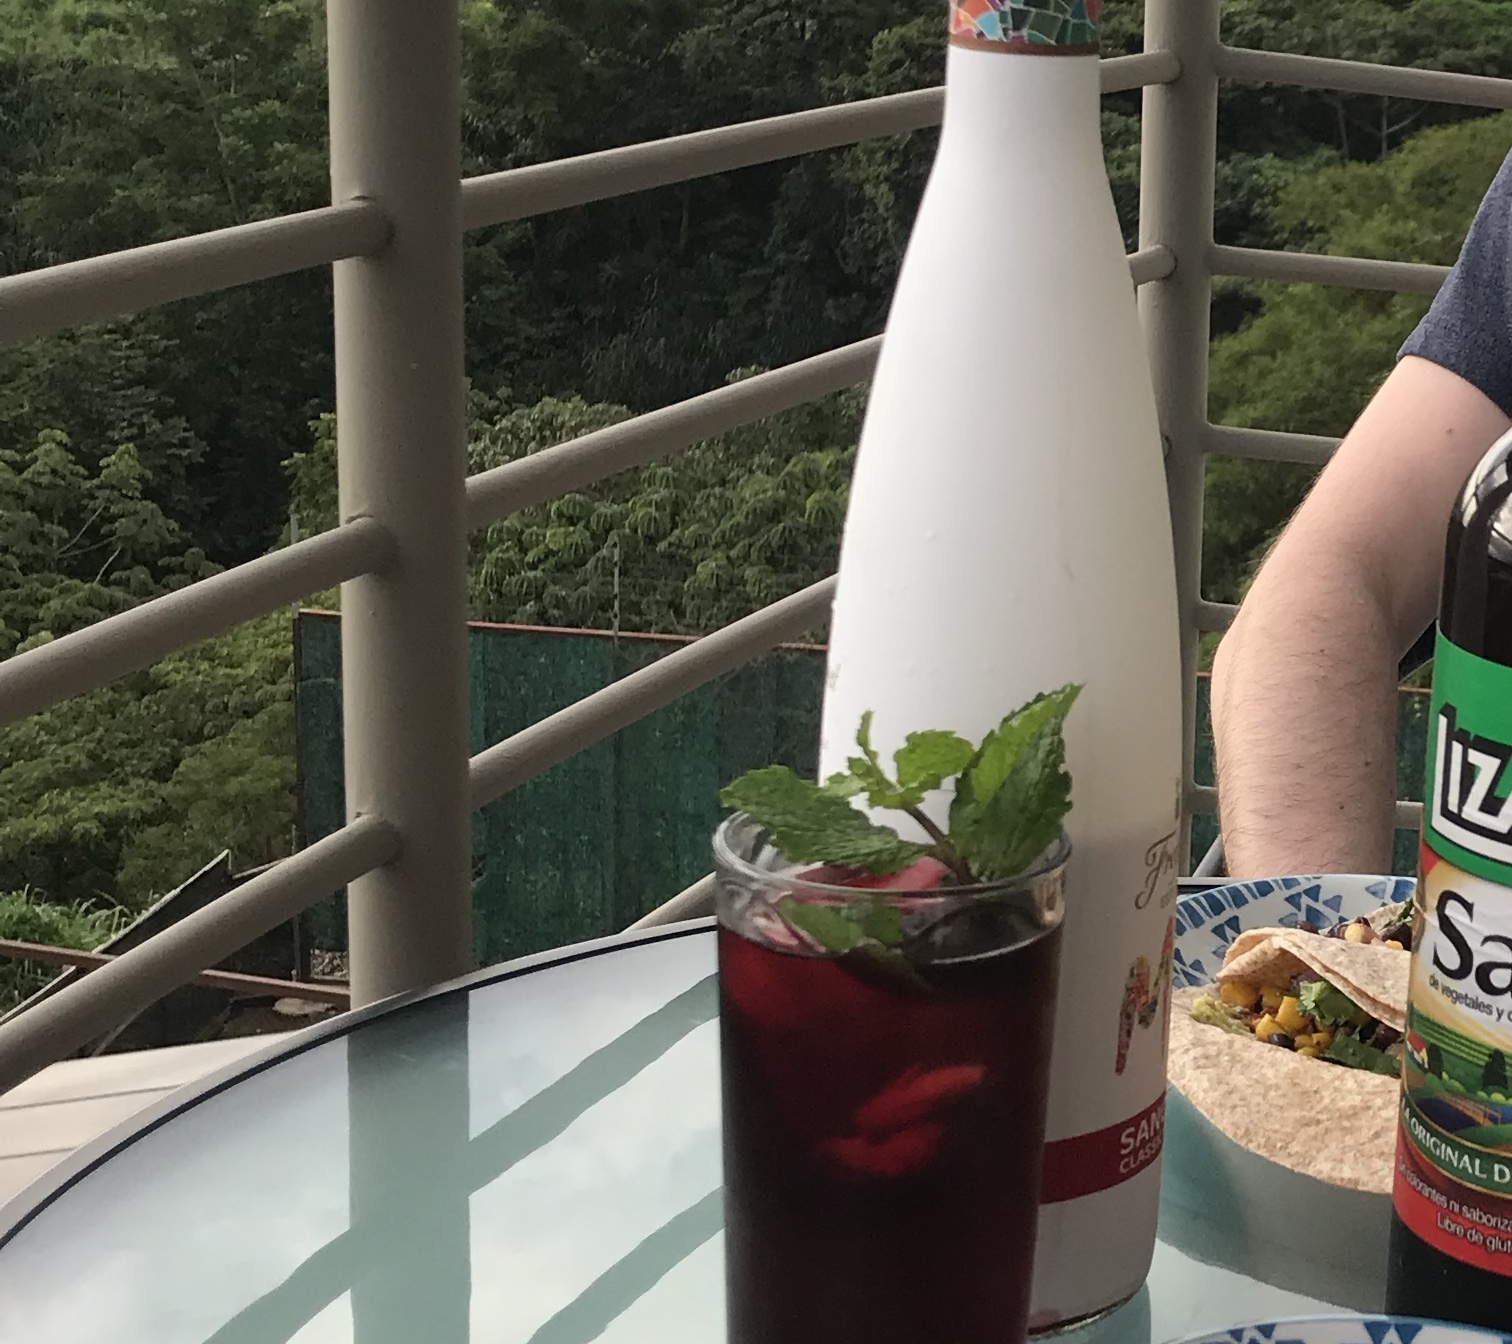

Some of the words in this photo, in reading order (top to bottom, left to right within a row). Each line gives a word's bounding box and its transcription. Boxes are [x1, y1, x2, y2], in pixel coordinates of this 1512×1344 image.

[1428, 974, 1440, 991] de
[1441, 982, 1494, 1016] vegetales
[1495, 1009, 1505, 1022] y
[1410, 1116, 1488, 1180] ORIGINAL
[1449, 1199, 1460, 1213] ni
[1437, 1212, 1464, 1239] Libre
[1466, 1227, 1484, 1245] de
